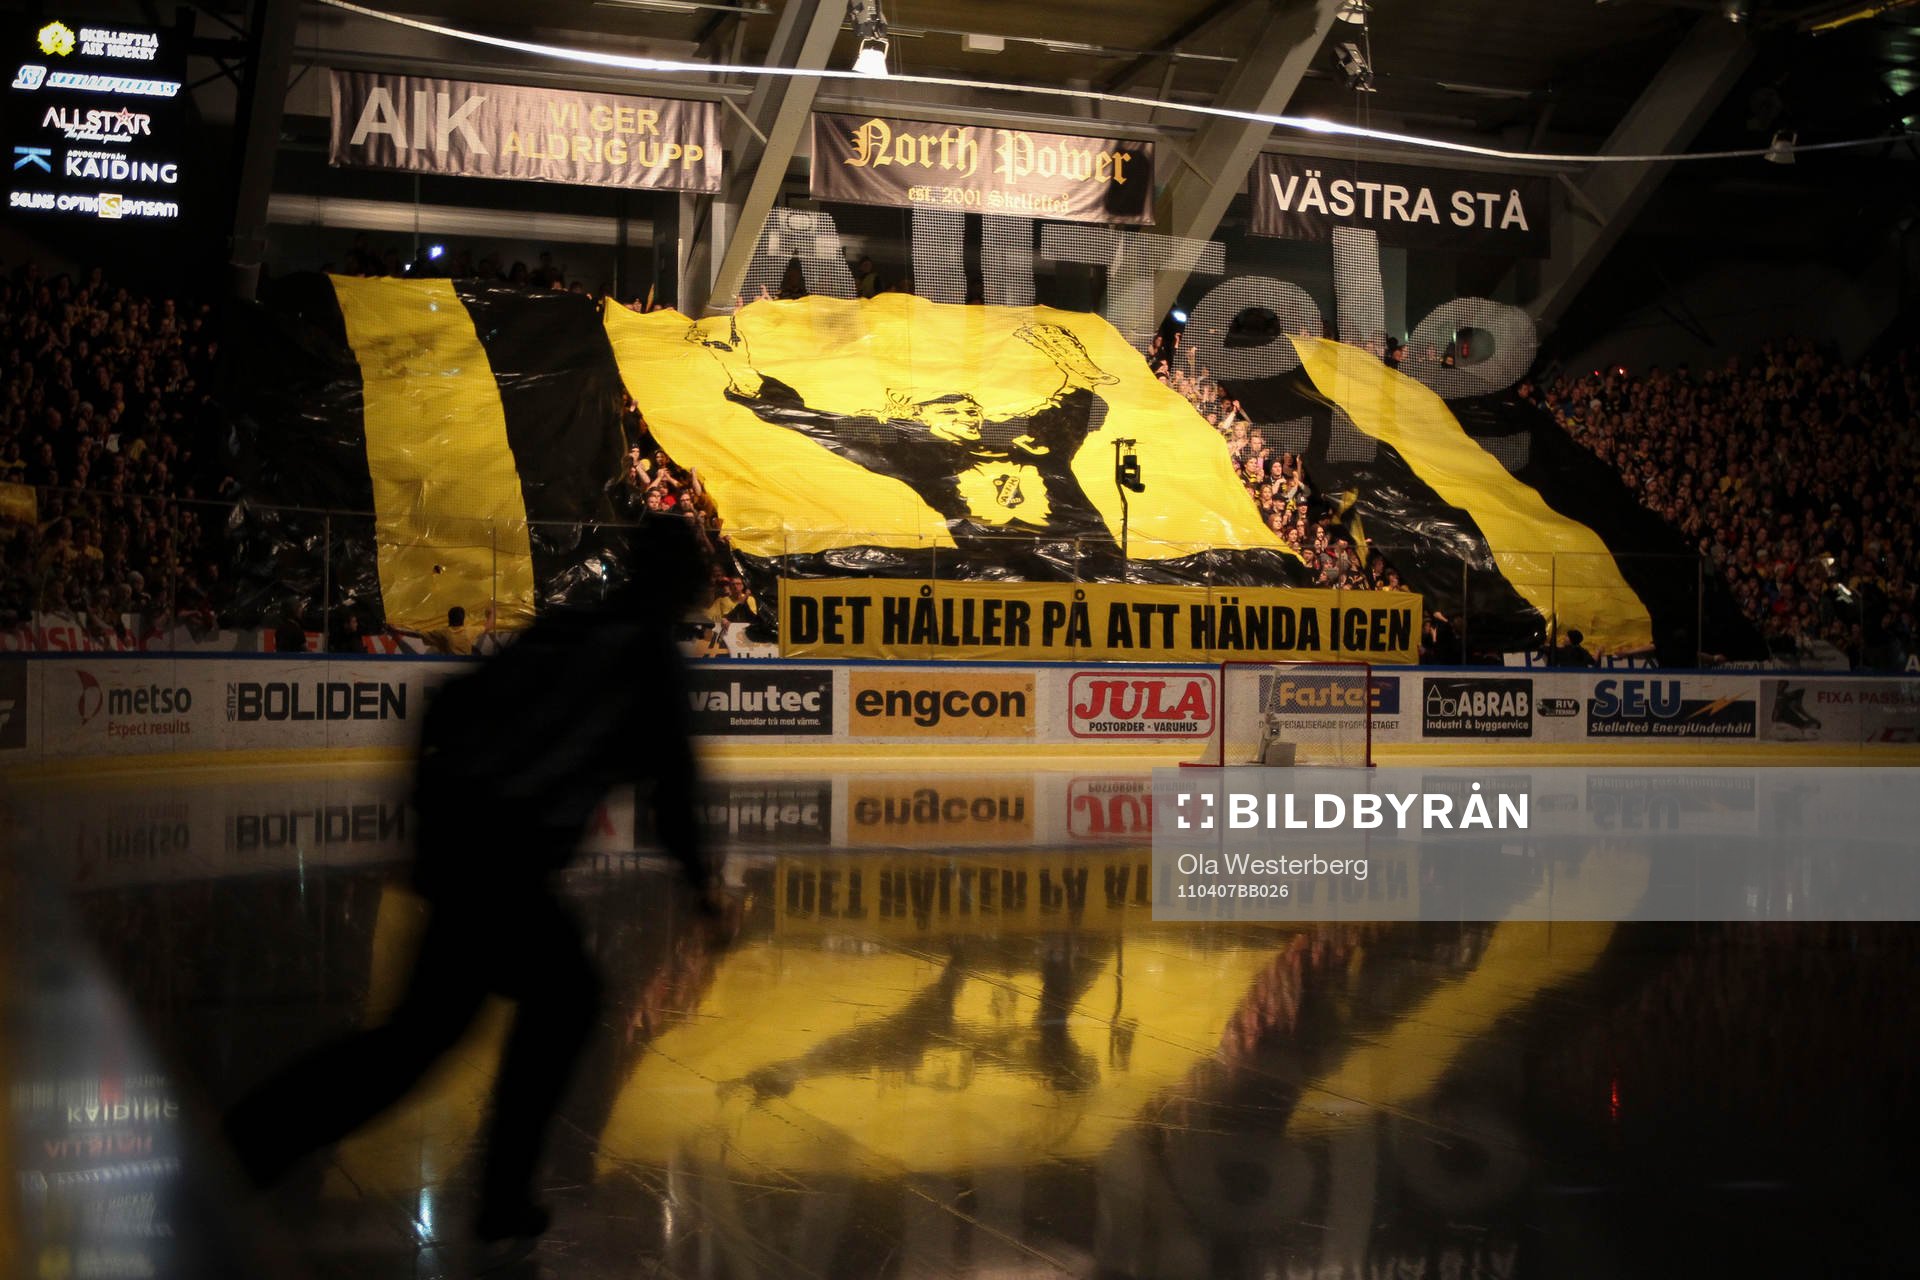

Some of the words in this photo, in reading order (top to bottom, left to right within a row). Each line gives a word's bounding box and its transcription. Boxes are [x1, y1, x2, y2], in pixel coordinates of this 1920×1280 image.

[43, 107, 151, 136] ALLSTAR
[350, 87, 489, 155] AIK
[548, 101, 580, 130] VI
[590, 104, 661, 136] GER
[503, 130, 628, 166] ALDRIG
[638, 140, 705, 170] UPP
[844, 118, 978, 178] North
[994, 127, 1132, 184] Power
[66, 157, 178, 184] KAIDING
[941, 186, 981, 206] 2001
[1270, 169, 1440, 225] VÄSTRA
[1450, 188, 1529, 232] STÅ
[789, 595, 872, 646] DET
[882, 584, 1031, 647] HÅLLER
[1042, 588, 1093, 648] PÅ
[1106, 602, 1180, 649] ATT
[1190, 596, 1322, 652] HÄNDA
[1330, 607, 1412, 652] IGEN
[108, 684, 192, 715] metso
[238, 682, 406, 721] BOLIDEN
[688, 682, 820, 712] valutec
[855, 689, 1027, 728] engcon
[1074, 680, 1210, 721] JULA
[1457, 690, 1529, 718] ABRAB
[1591, 678, 1682, 719] SEU
[1817, 691, 1854, 705] FIXA
[108, 720, 148, 738] Expect
[150, 718, 191, 735] results
[730, 717, 766, 726] Behandlar
[779, 717, 796, 726] med
[1089, 721, 1145, 732] POSTORDER
[1154, 721, 1198, 732] VARUHUS
[1465, 719, 1473, 729] &
[1475, 719, 1529, 732] byggservice
[1591, 721, 1649, 734] Skellefteå
